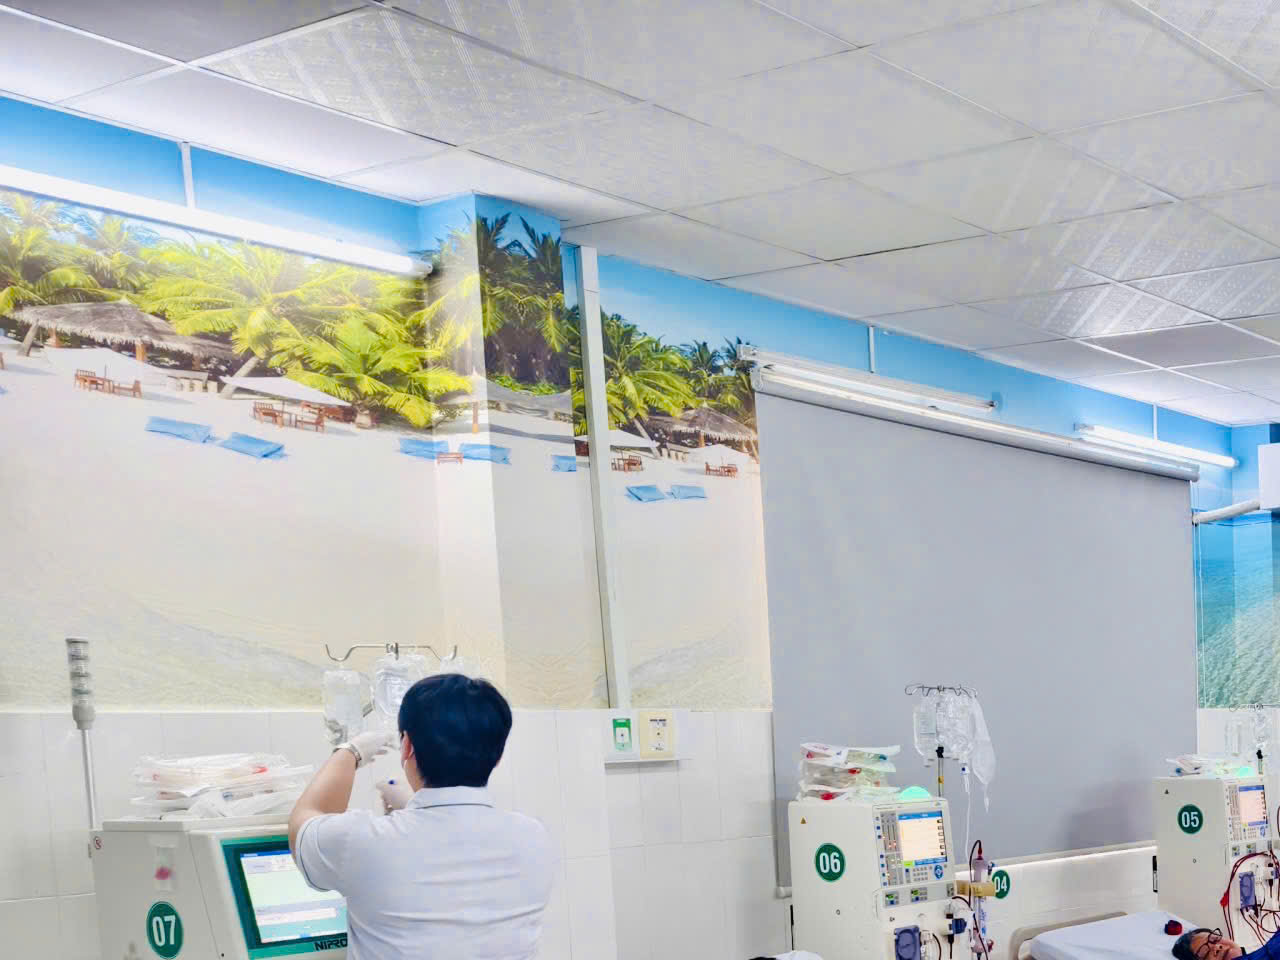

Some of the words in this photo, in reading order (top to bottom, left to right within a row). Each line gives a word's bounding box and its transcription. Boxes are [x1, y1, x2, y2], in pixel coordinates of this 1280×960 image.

[1181, 811, 1200, 828] 05
[819, 852, 841, 873] 06
[994, 875, 1008, 893] 04
[151, 915, 177, 948] 07
[314, 938, 348, 951] NIPRO
